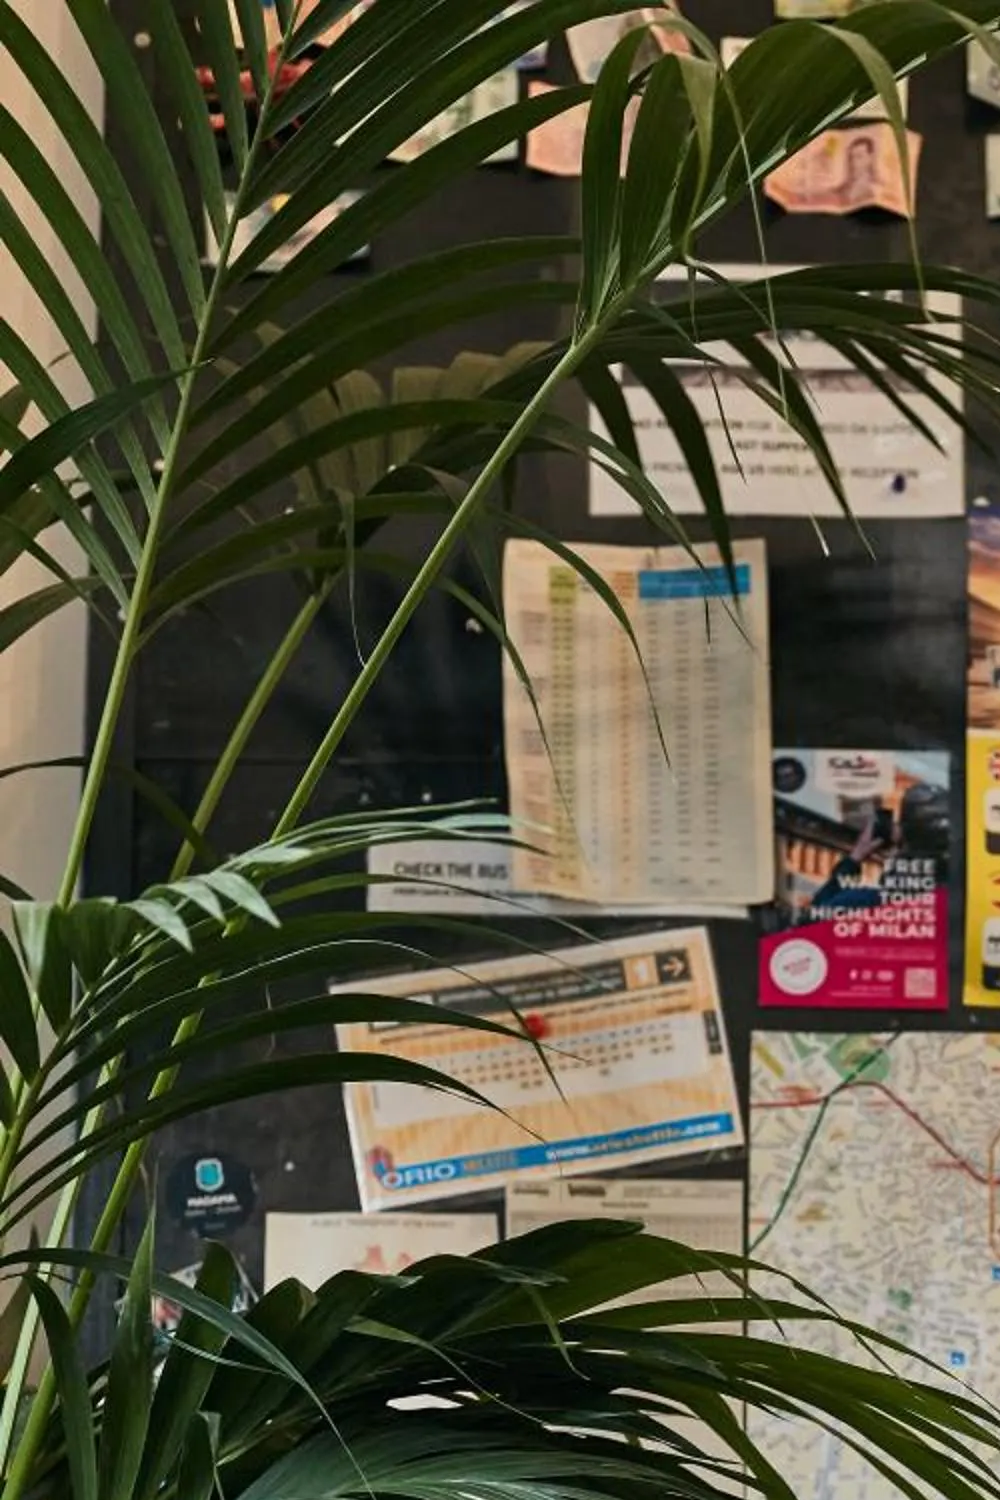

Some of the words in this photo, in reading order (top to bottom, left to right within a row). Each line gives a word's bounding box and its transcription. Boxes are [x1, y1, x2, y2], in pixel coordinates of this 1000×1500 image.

[394, 862, 442, 878] CHECK
[448, 864, 473, 878] THE
[478, 864, 508, 880] BUS
[883, 858, 936, 874] FREE
[879, 892, 936, 906] TOUR
[810, 907, 936, 922] HIGHLIGHTS
[833, 922, 863, 938] OF
[868, 923, 936, 939] MILAN
[382, 1164, 456, 1190] ORIO
